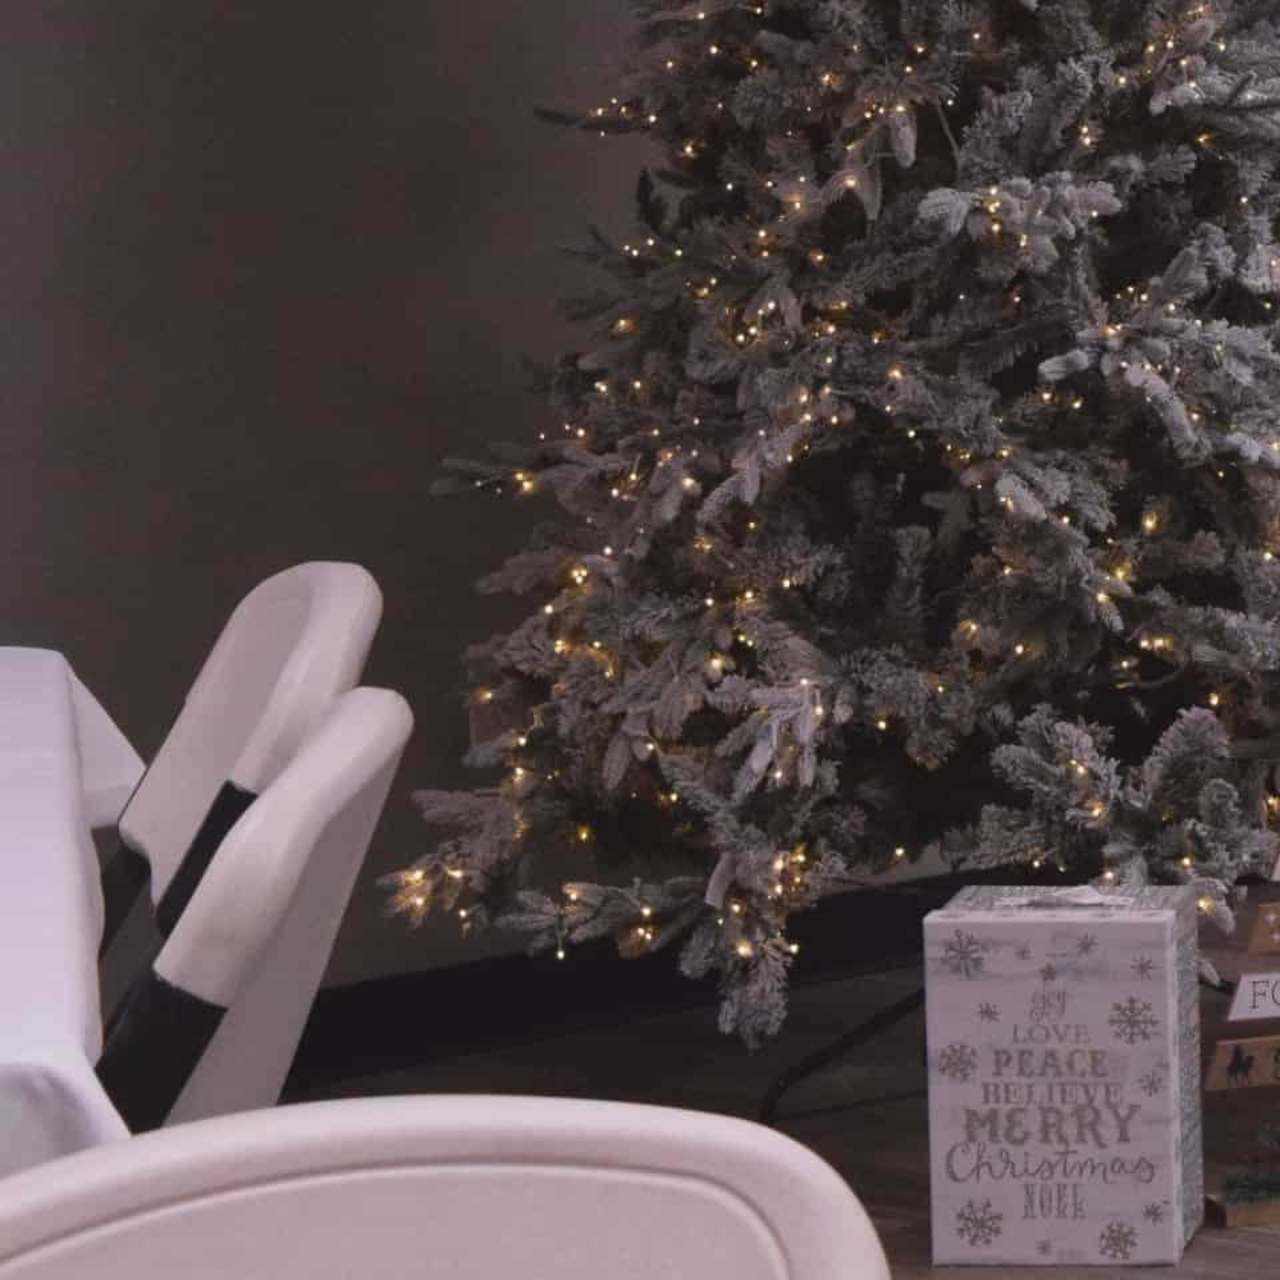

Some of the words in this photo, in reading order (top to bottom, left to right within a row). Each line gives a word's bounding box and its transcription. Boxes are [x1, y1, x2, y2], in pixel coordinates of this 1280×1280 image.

[1012, 1023, 1092, 1044] LOVE
[992, 1048, 1109, 1078] PEACE
[982, 1081, 1122, 1105] BELIEVE
[963, 1104, 1142, 1149] MERRY
[945, 1140, 1156, 1184] Christmas
[1022, 1182, 1088, 1219] NOEL
